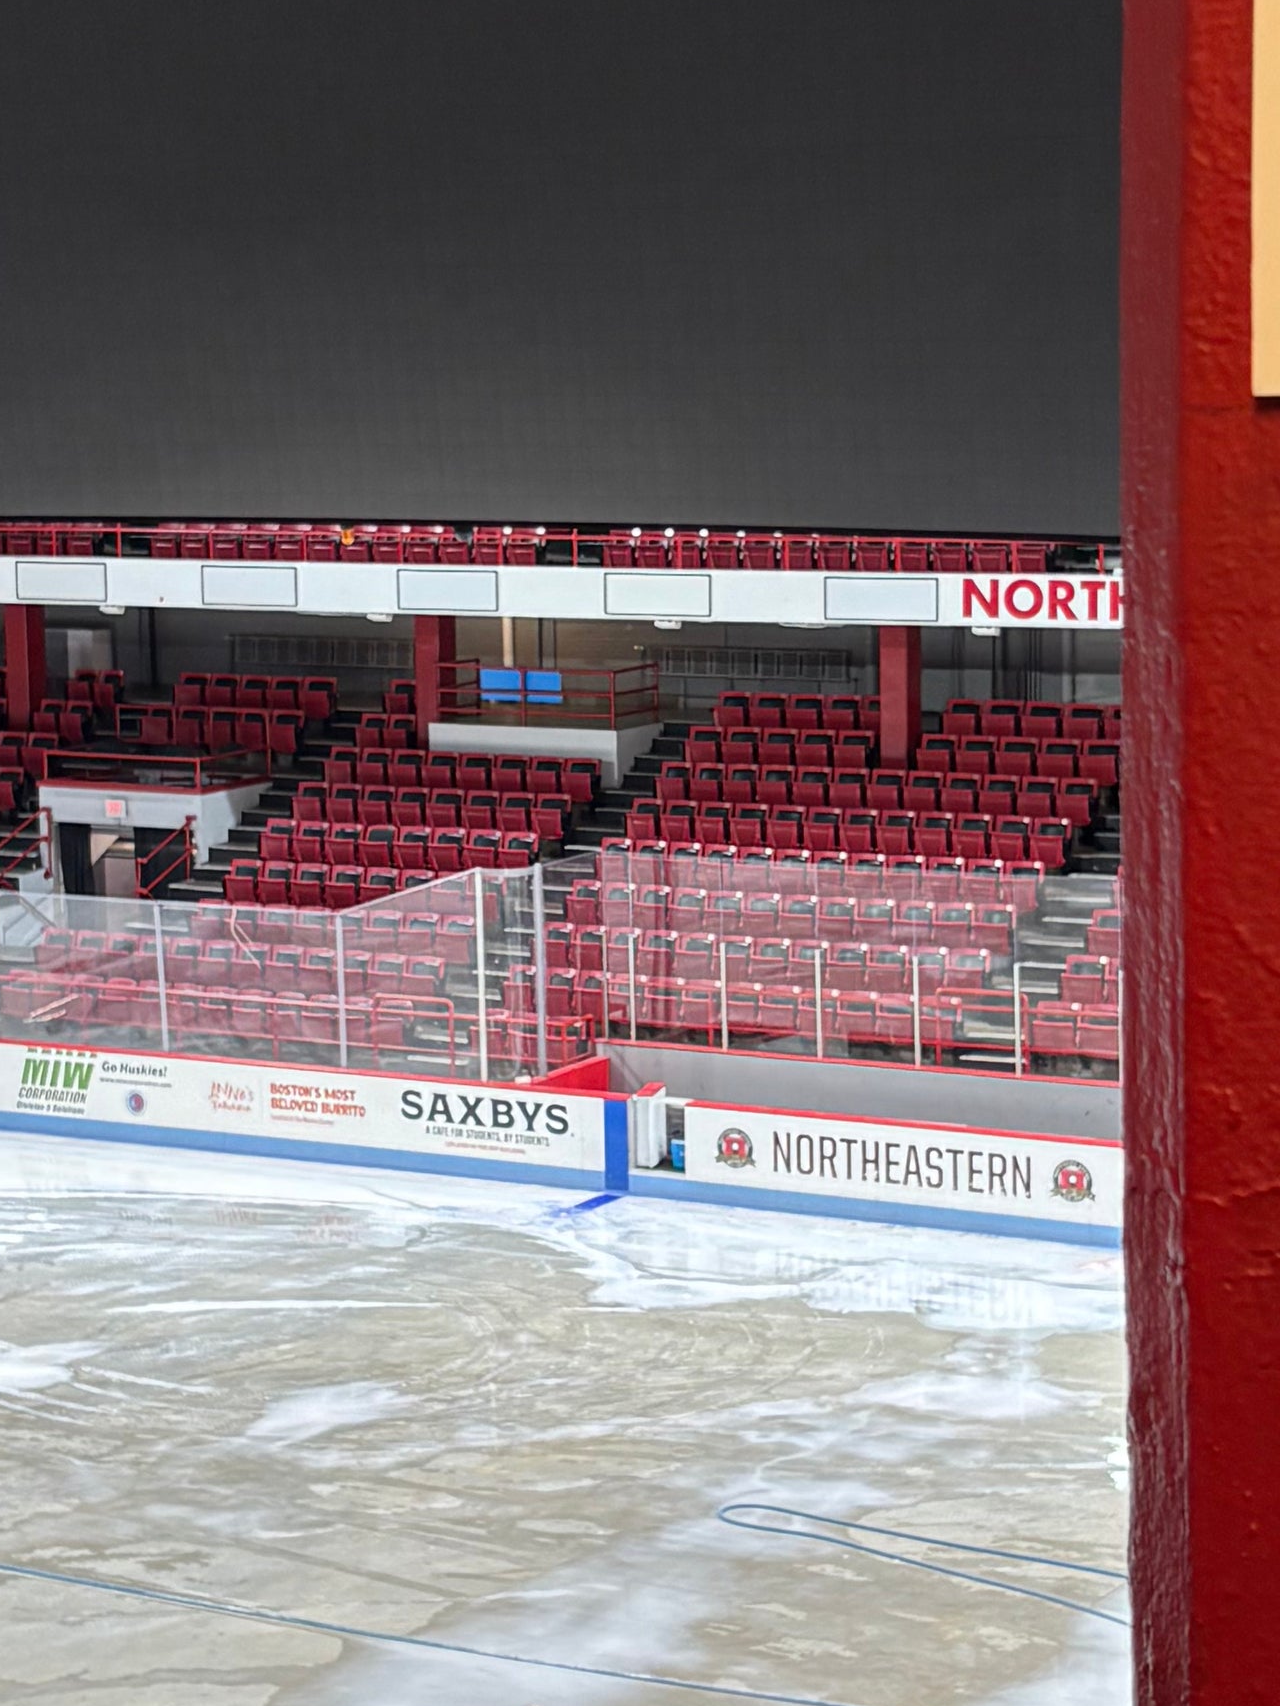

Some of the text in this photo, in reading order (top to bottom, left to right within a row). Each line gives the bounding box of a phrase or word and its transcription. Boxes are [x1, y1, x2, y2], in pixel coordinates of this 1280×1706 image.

[20, 1058, 95, 1090] MIW
[101, 1061, 168, 1078] Go Huskies!
[18, 1086, 87, 1104] CORPORATION
[270, 1083, 356, 1101] BOSTON'S MOST
[271, 1097, 367, 1118] BELOVED BURRITO
[401, 1090, 569, 1135] SAXBYS
[425, 1125, 431, 1134] A
[451, 1127, 463, 1137] FOR
[504, 1132, 514, 1143] BY
[773, 1131, 1032, 1199] NORTHEASTERN
